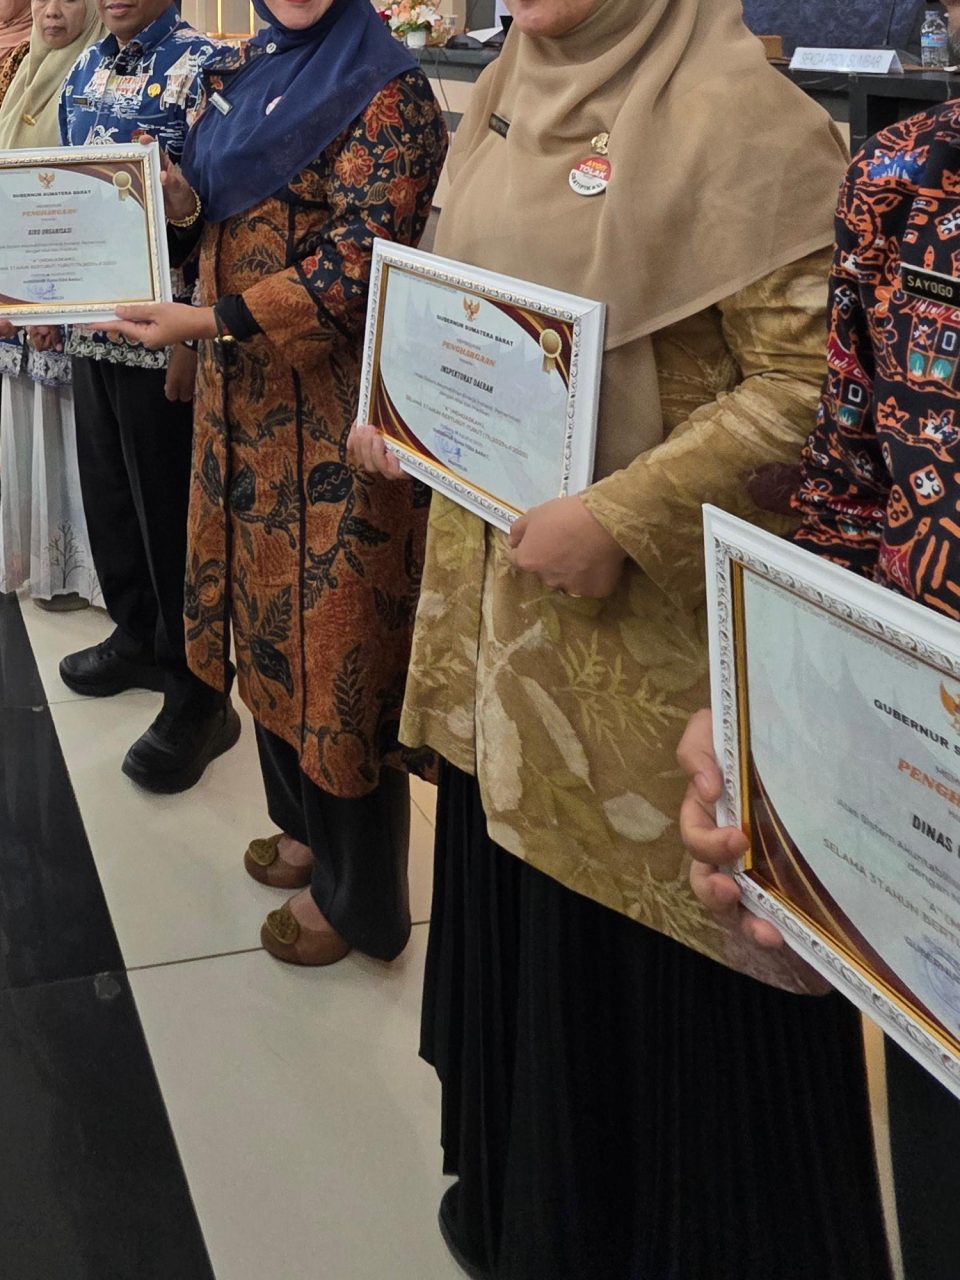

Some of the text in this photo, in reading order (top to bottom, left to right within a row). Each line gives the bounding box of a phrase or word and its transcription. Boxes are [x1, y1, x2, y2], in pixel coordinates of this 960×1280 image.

[579, 164, 607, 179] TOLAK
[906, 275, 953, 298] SAYOGO
[436, 314, 464, 329] GUBERNUR
[464, 324, 494, 340] SUMATERA
[494, 335, 514, 347] BARAT
[441, 340, 496, 367] PENGHARGAAN
[440, 365, 494, 394] INSPEKTORAT DAERAH
[874, 699, 950, 750] GUBERNUR
[912, 813, 953, 853] DINAS
[823, 837, 867, 877] SELAMA
